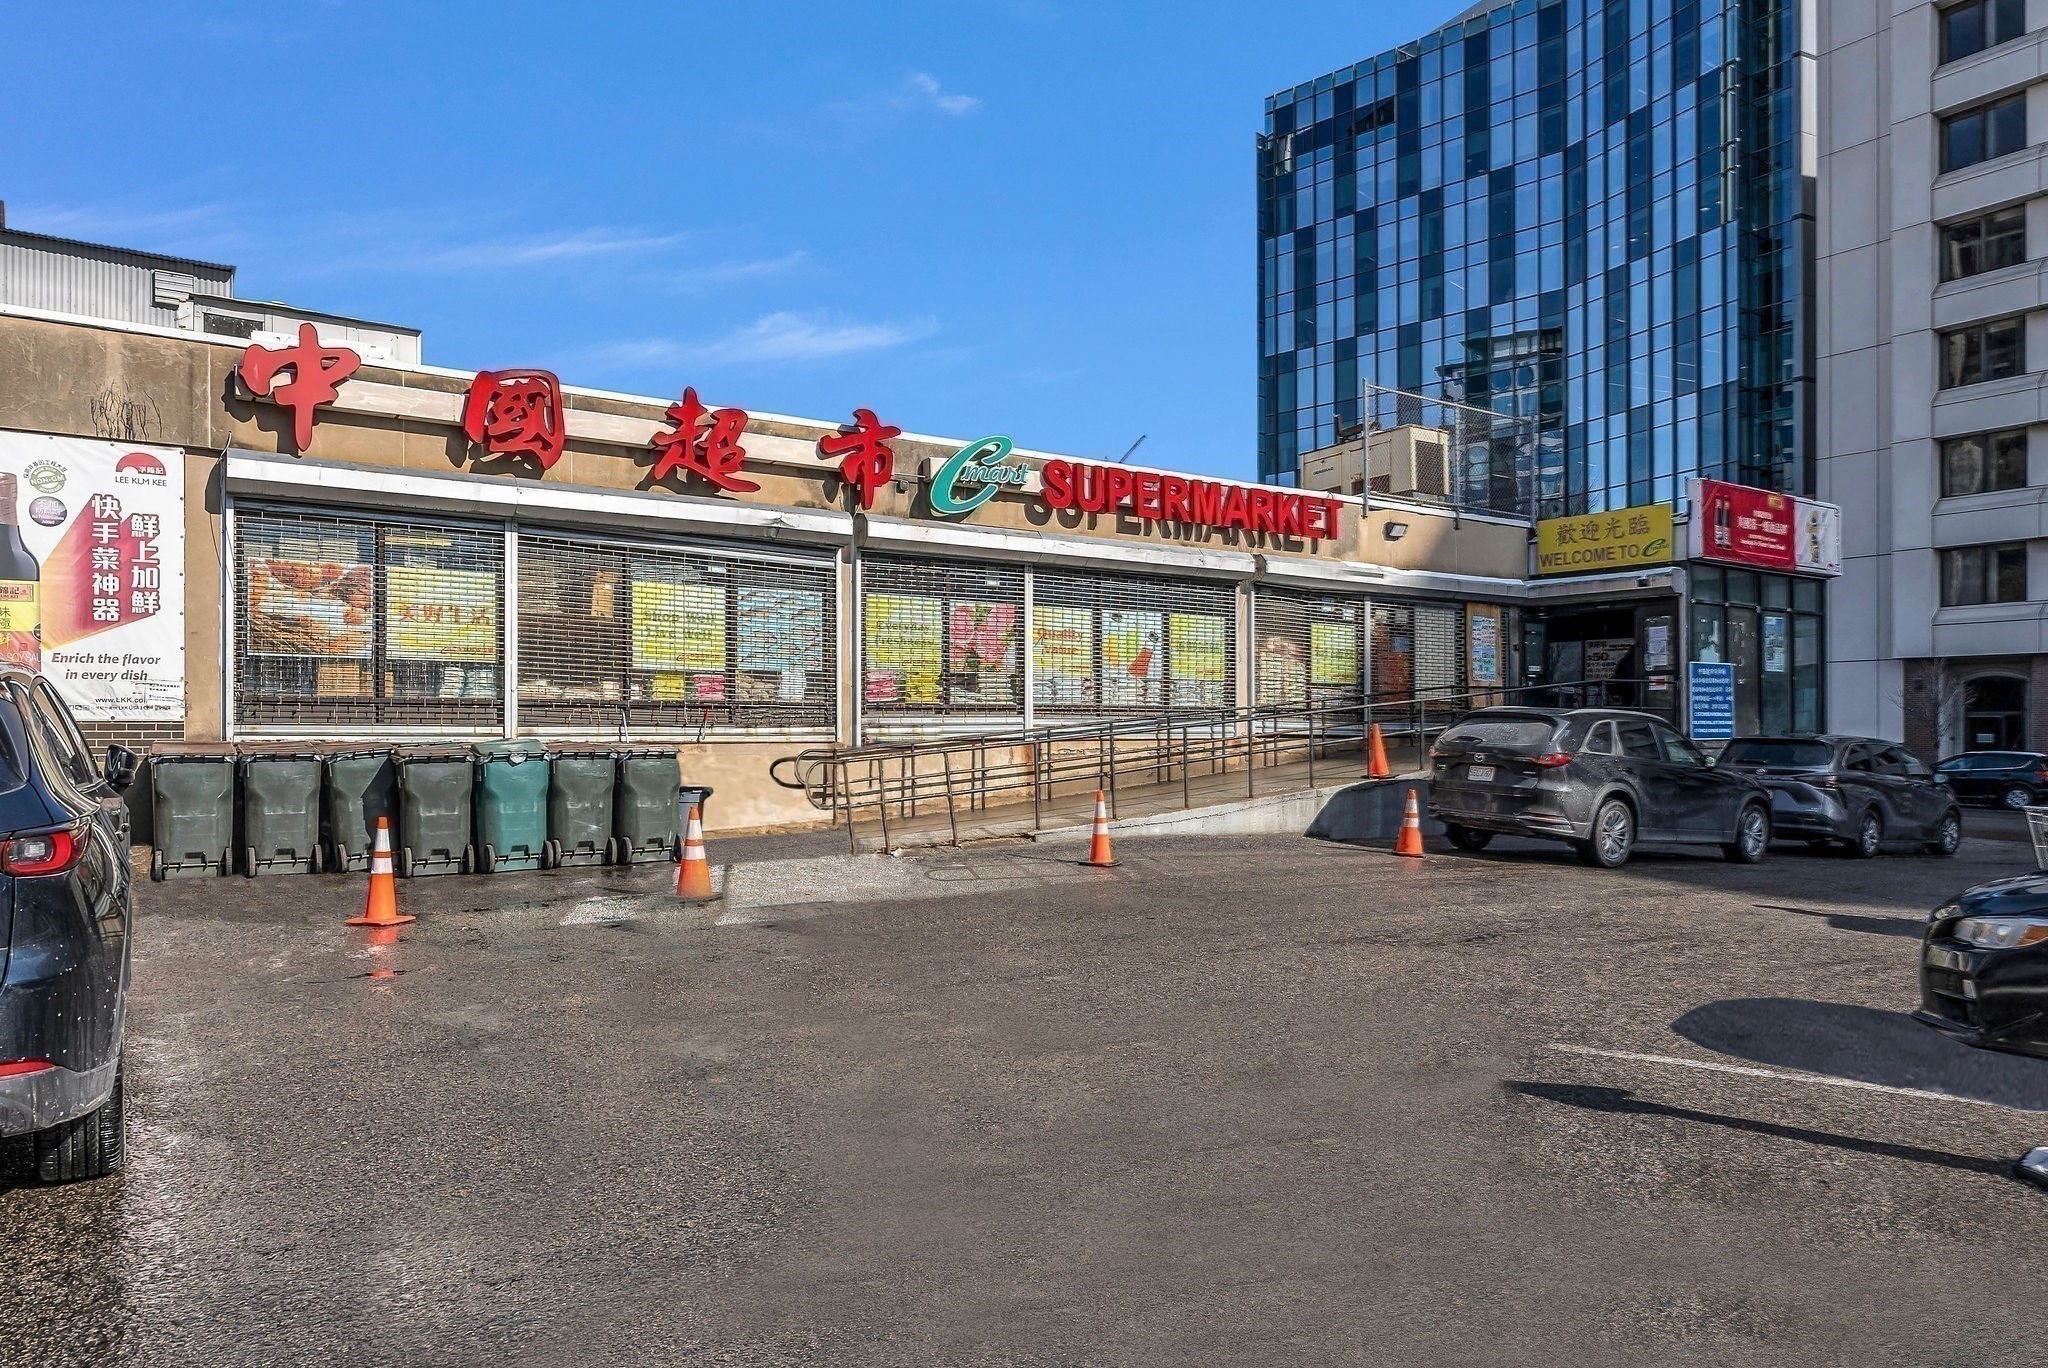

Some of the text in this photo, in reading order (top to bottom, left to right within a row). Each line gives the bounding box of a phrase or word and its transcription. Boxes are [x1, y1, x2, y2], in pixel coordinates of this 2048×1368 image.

[239, 322, 902, 511] 中國超市
[114, 476, 130, 484] LEE
[152, 479, 168, 487] KEE
[1041, 458, 1342, 540] SUPERMARKET
[1554, 514, 1650, 547] 歡迎光臨
[91, 494, 120, 622] 快手菜神器
[130, 513, 160, 614] 鮮上加鮮
[1539, 547, 1615, 567] WELCOME
[1618, 543, 1639, 559] TO
[51, 652, 161, 666] Enrich the flavor
[65, 669, 148, 682] in every dish
